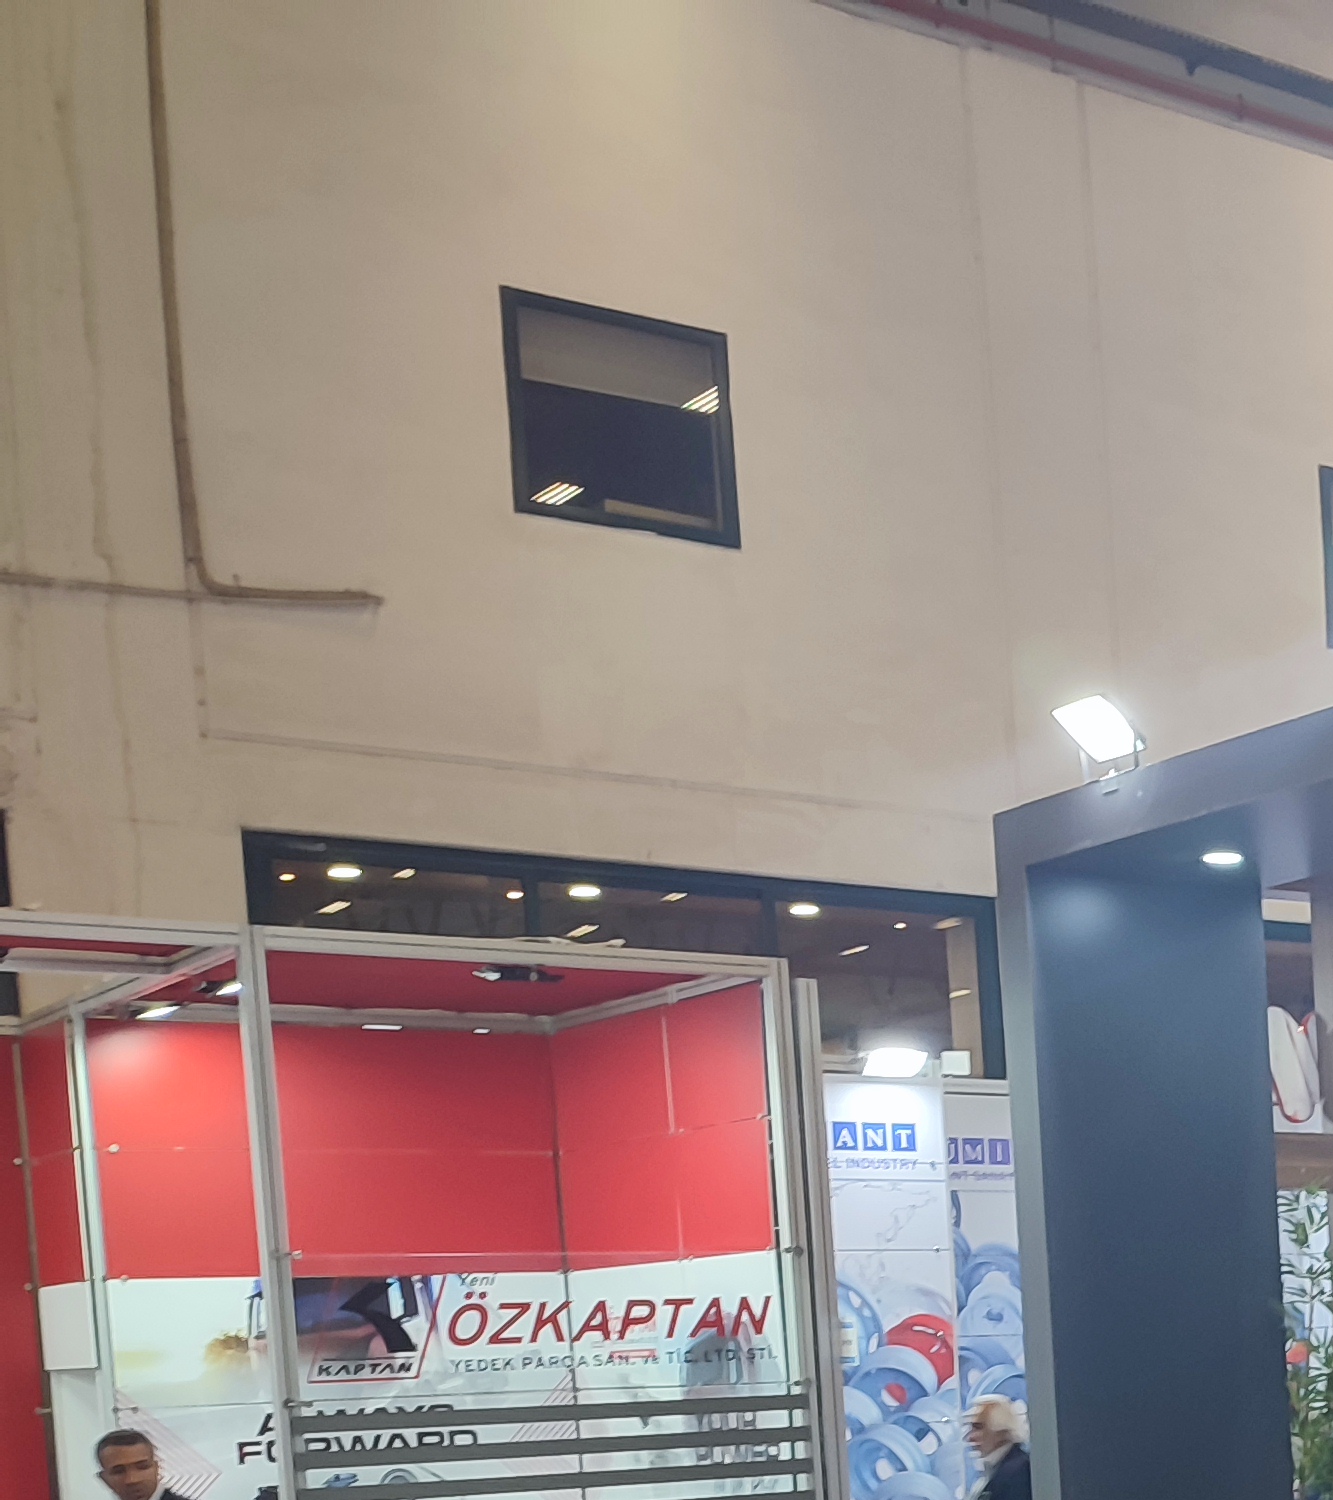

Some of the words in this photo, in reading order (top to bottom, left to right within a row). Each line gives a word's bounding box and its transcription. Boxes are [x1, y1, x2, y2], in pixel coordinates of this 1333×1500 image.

[459, 1272, 497, 1287] Yeni
[448, 1291, 773, 1346] ÖZKAPTAN
[316, 1361, 414, 1377] KAPTAN
[450, 1356, 515, 1373] YEDEK
